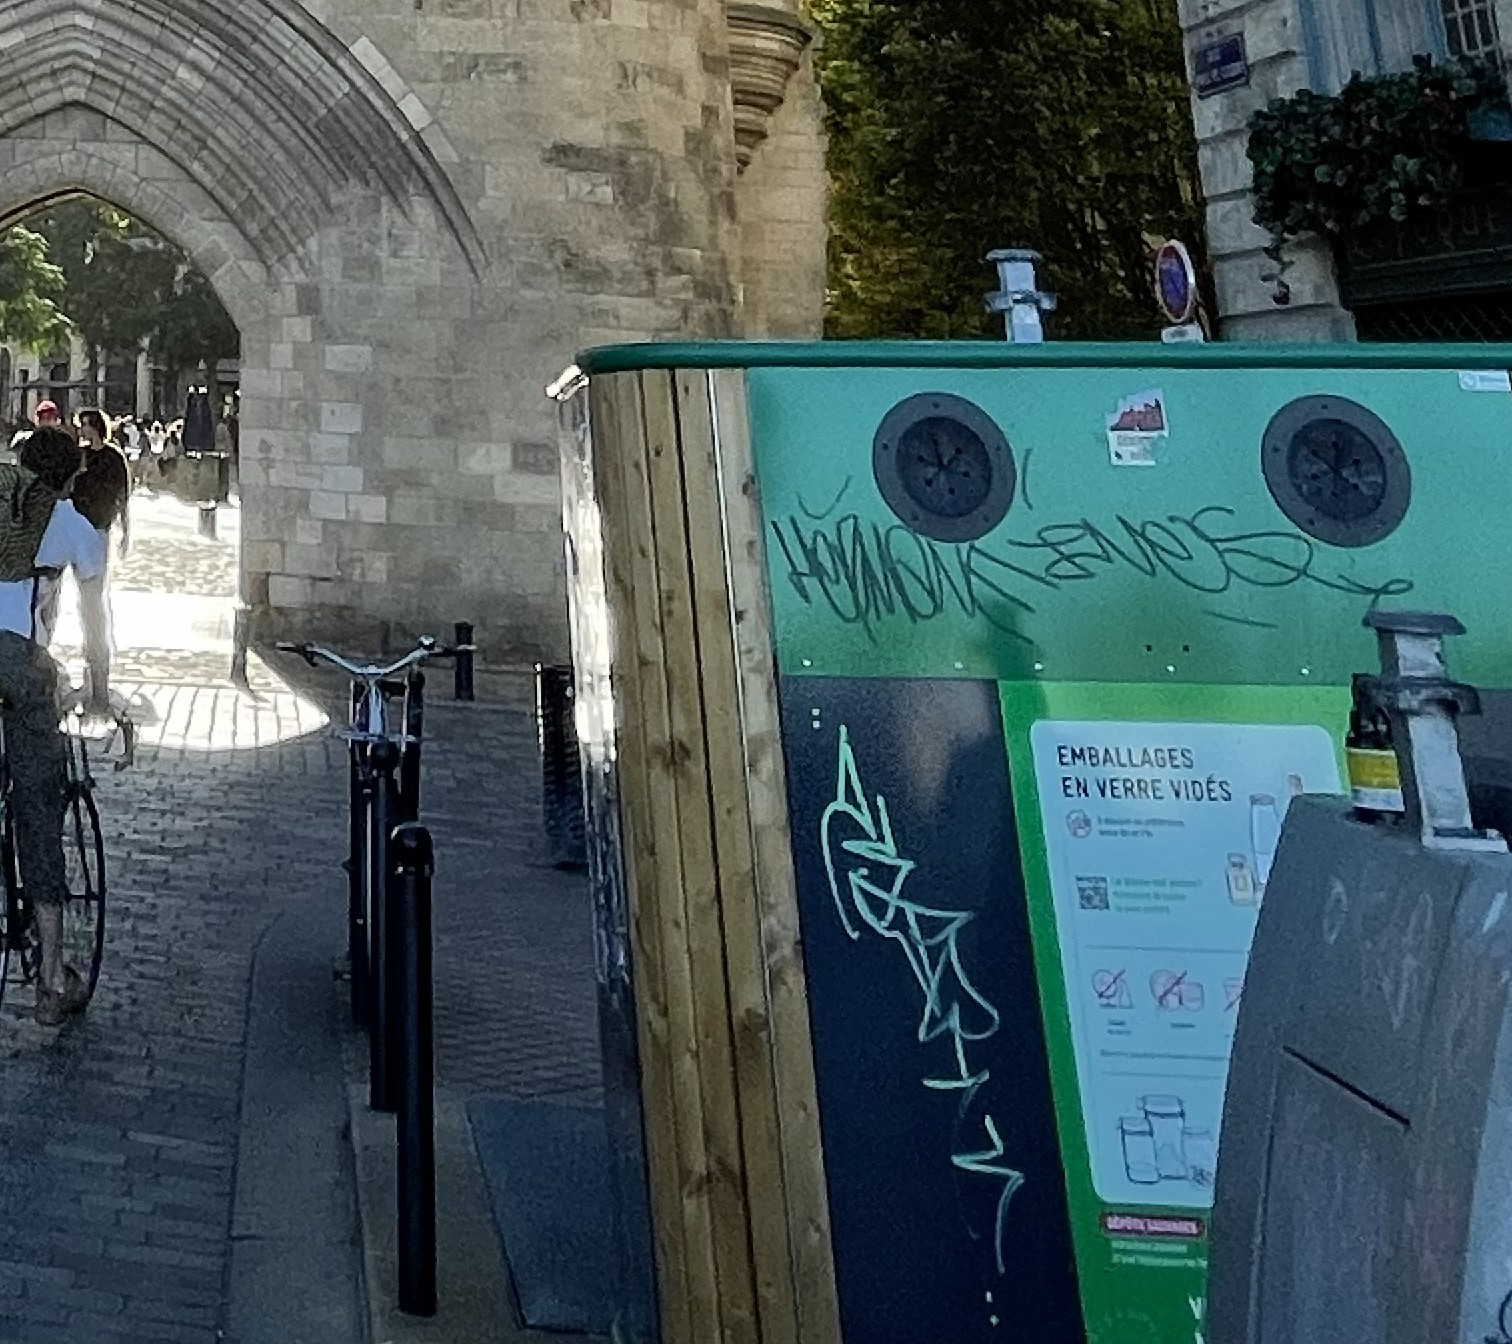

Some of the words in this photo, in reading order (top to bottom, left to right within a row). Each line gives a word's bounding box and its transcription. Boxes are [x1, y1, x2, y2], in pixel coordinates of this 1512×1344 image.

[1057, 745, 1194, 769] EMBALLAGES
[1062, 777, 1089, 798] EN
[1096, 777, 1165, 800] VERRE
[1169, 773, 1232, 801] VIDÉS
